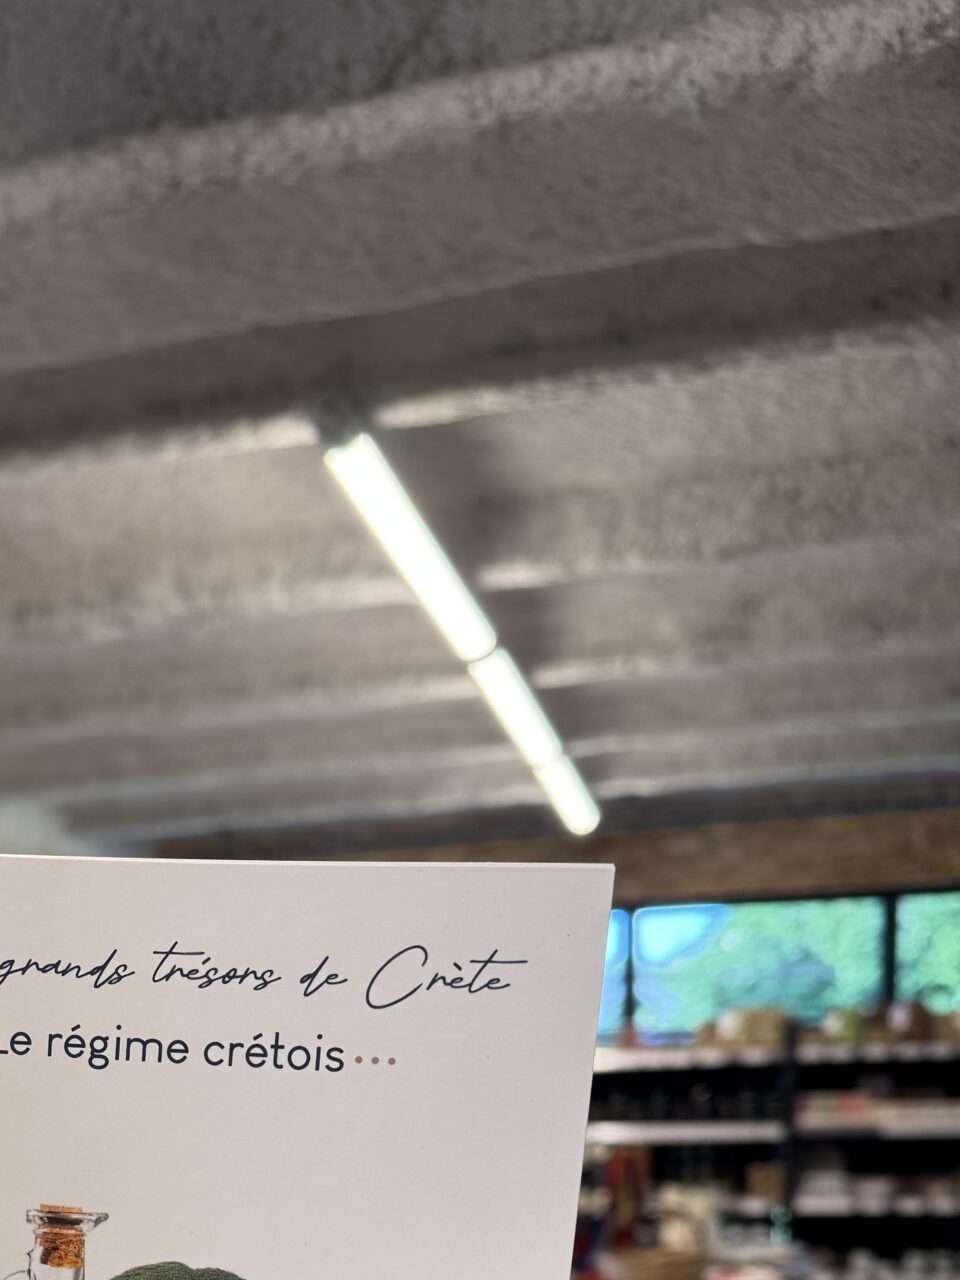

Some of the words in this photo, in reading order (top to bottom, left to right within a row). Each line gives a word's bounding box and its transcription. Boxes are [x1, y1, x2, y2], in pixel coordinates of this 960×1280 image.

[151, 941, 283, 992] trésors
[299, 955, 348, 998] de
[365, 944, 529, 1010] Crète
[47, 1023, 189, 1070] régime
[203, 1031, 345, 1073] crétois
